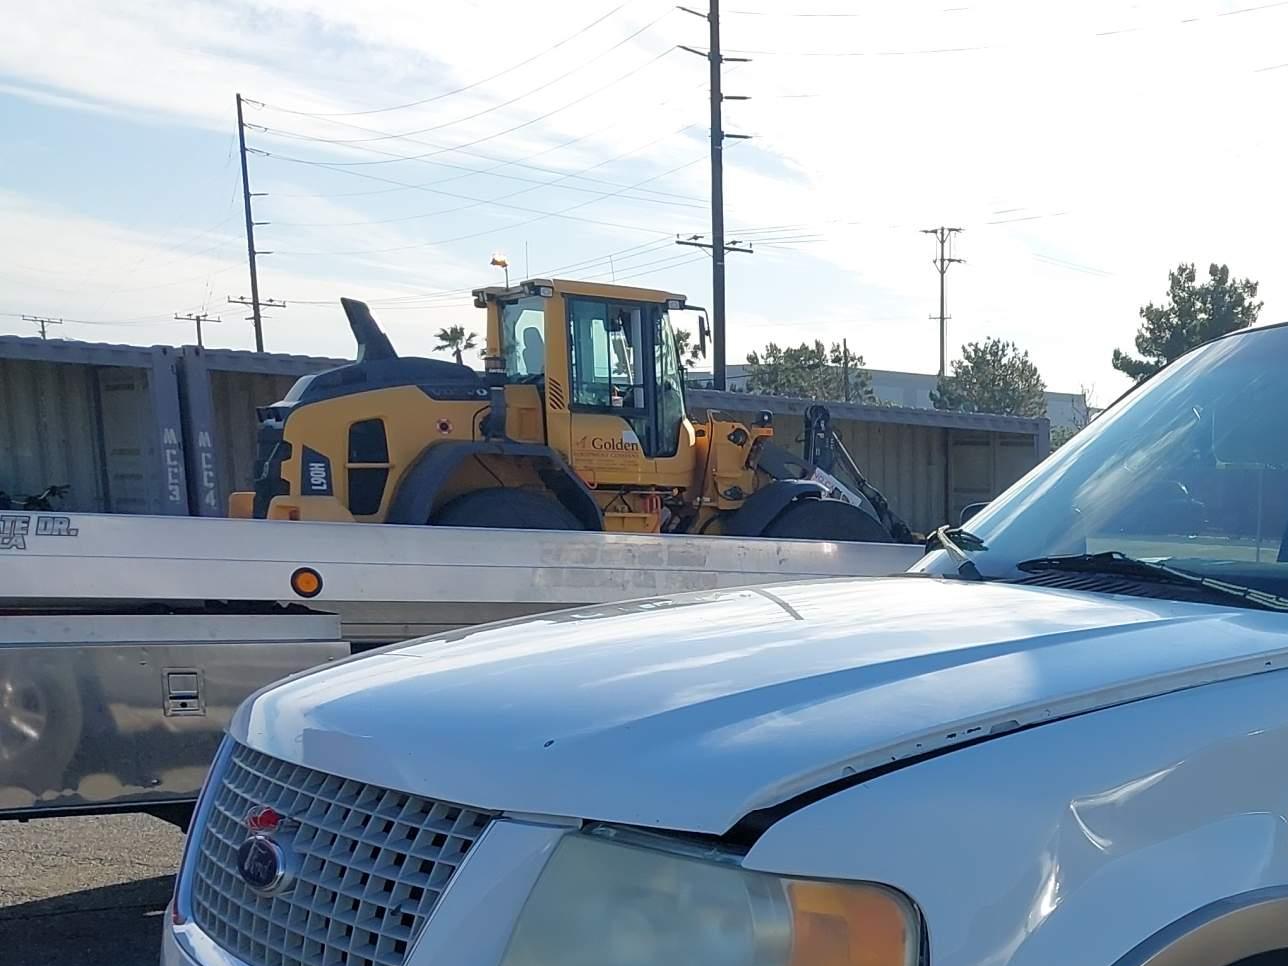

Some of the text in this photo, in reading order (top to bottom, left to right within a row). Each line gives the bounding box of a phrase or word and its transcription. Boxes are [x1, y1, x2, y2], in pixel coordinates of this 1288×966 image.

[591, 436, 640, 451] Golden
[309, 463, 328, 490] L90H
[35, 515, 79, 537] DR.
